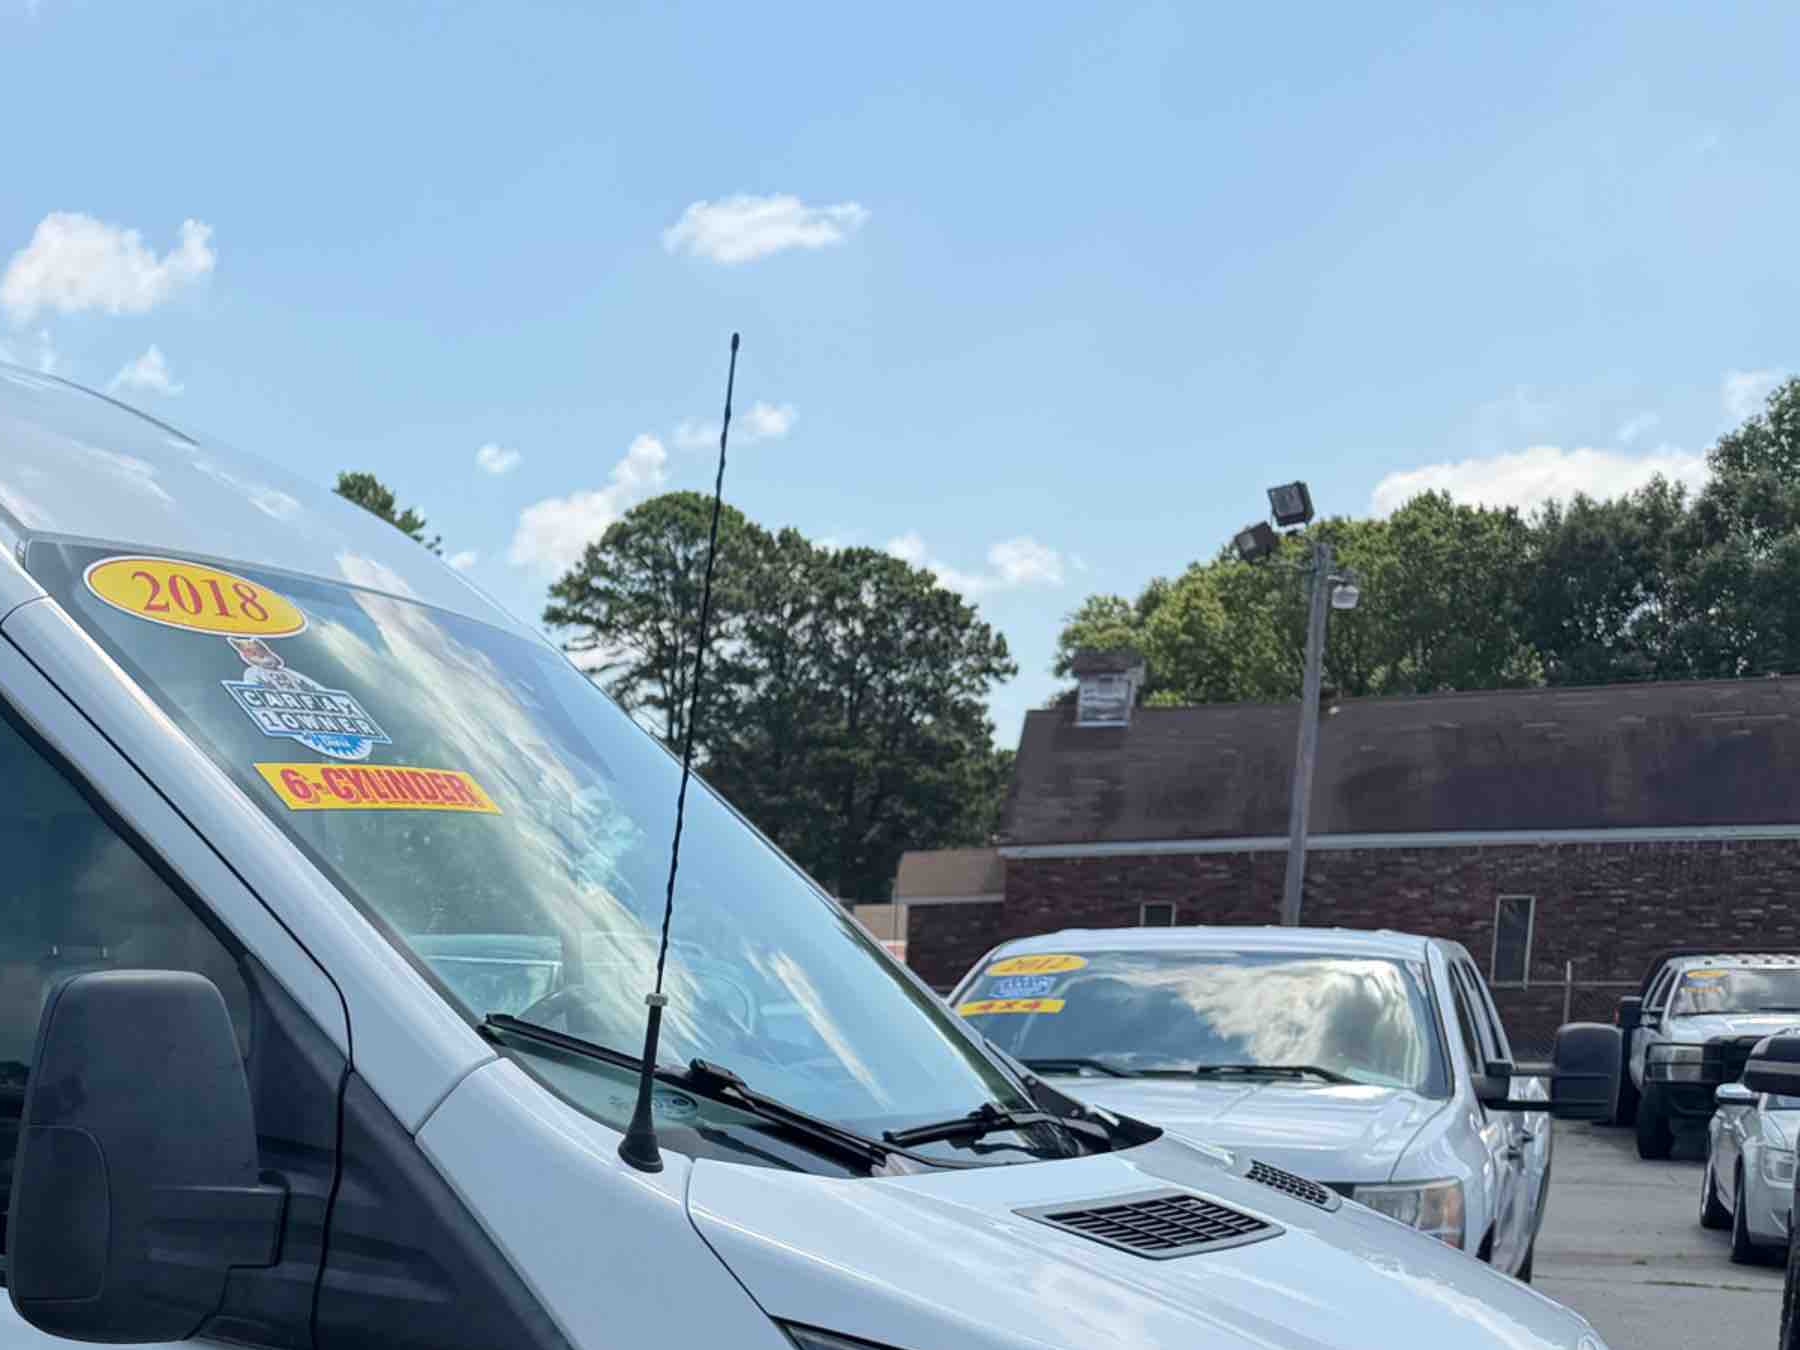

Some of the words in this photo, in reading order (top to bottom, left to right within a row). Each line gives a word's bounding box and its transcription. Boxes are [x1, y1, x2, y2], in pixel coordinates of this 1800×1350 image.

[131, 570, 269, 622] 2018
[243, 689, 363, 720] CARFAX
[280, 712, 377, 736] OWNER
[279, 767, 483, 807] 6-CYLINDER
